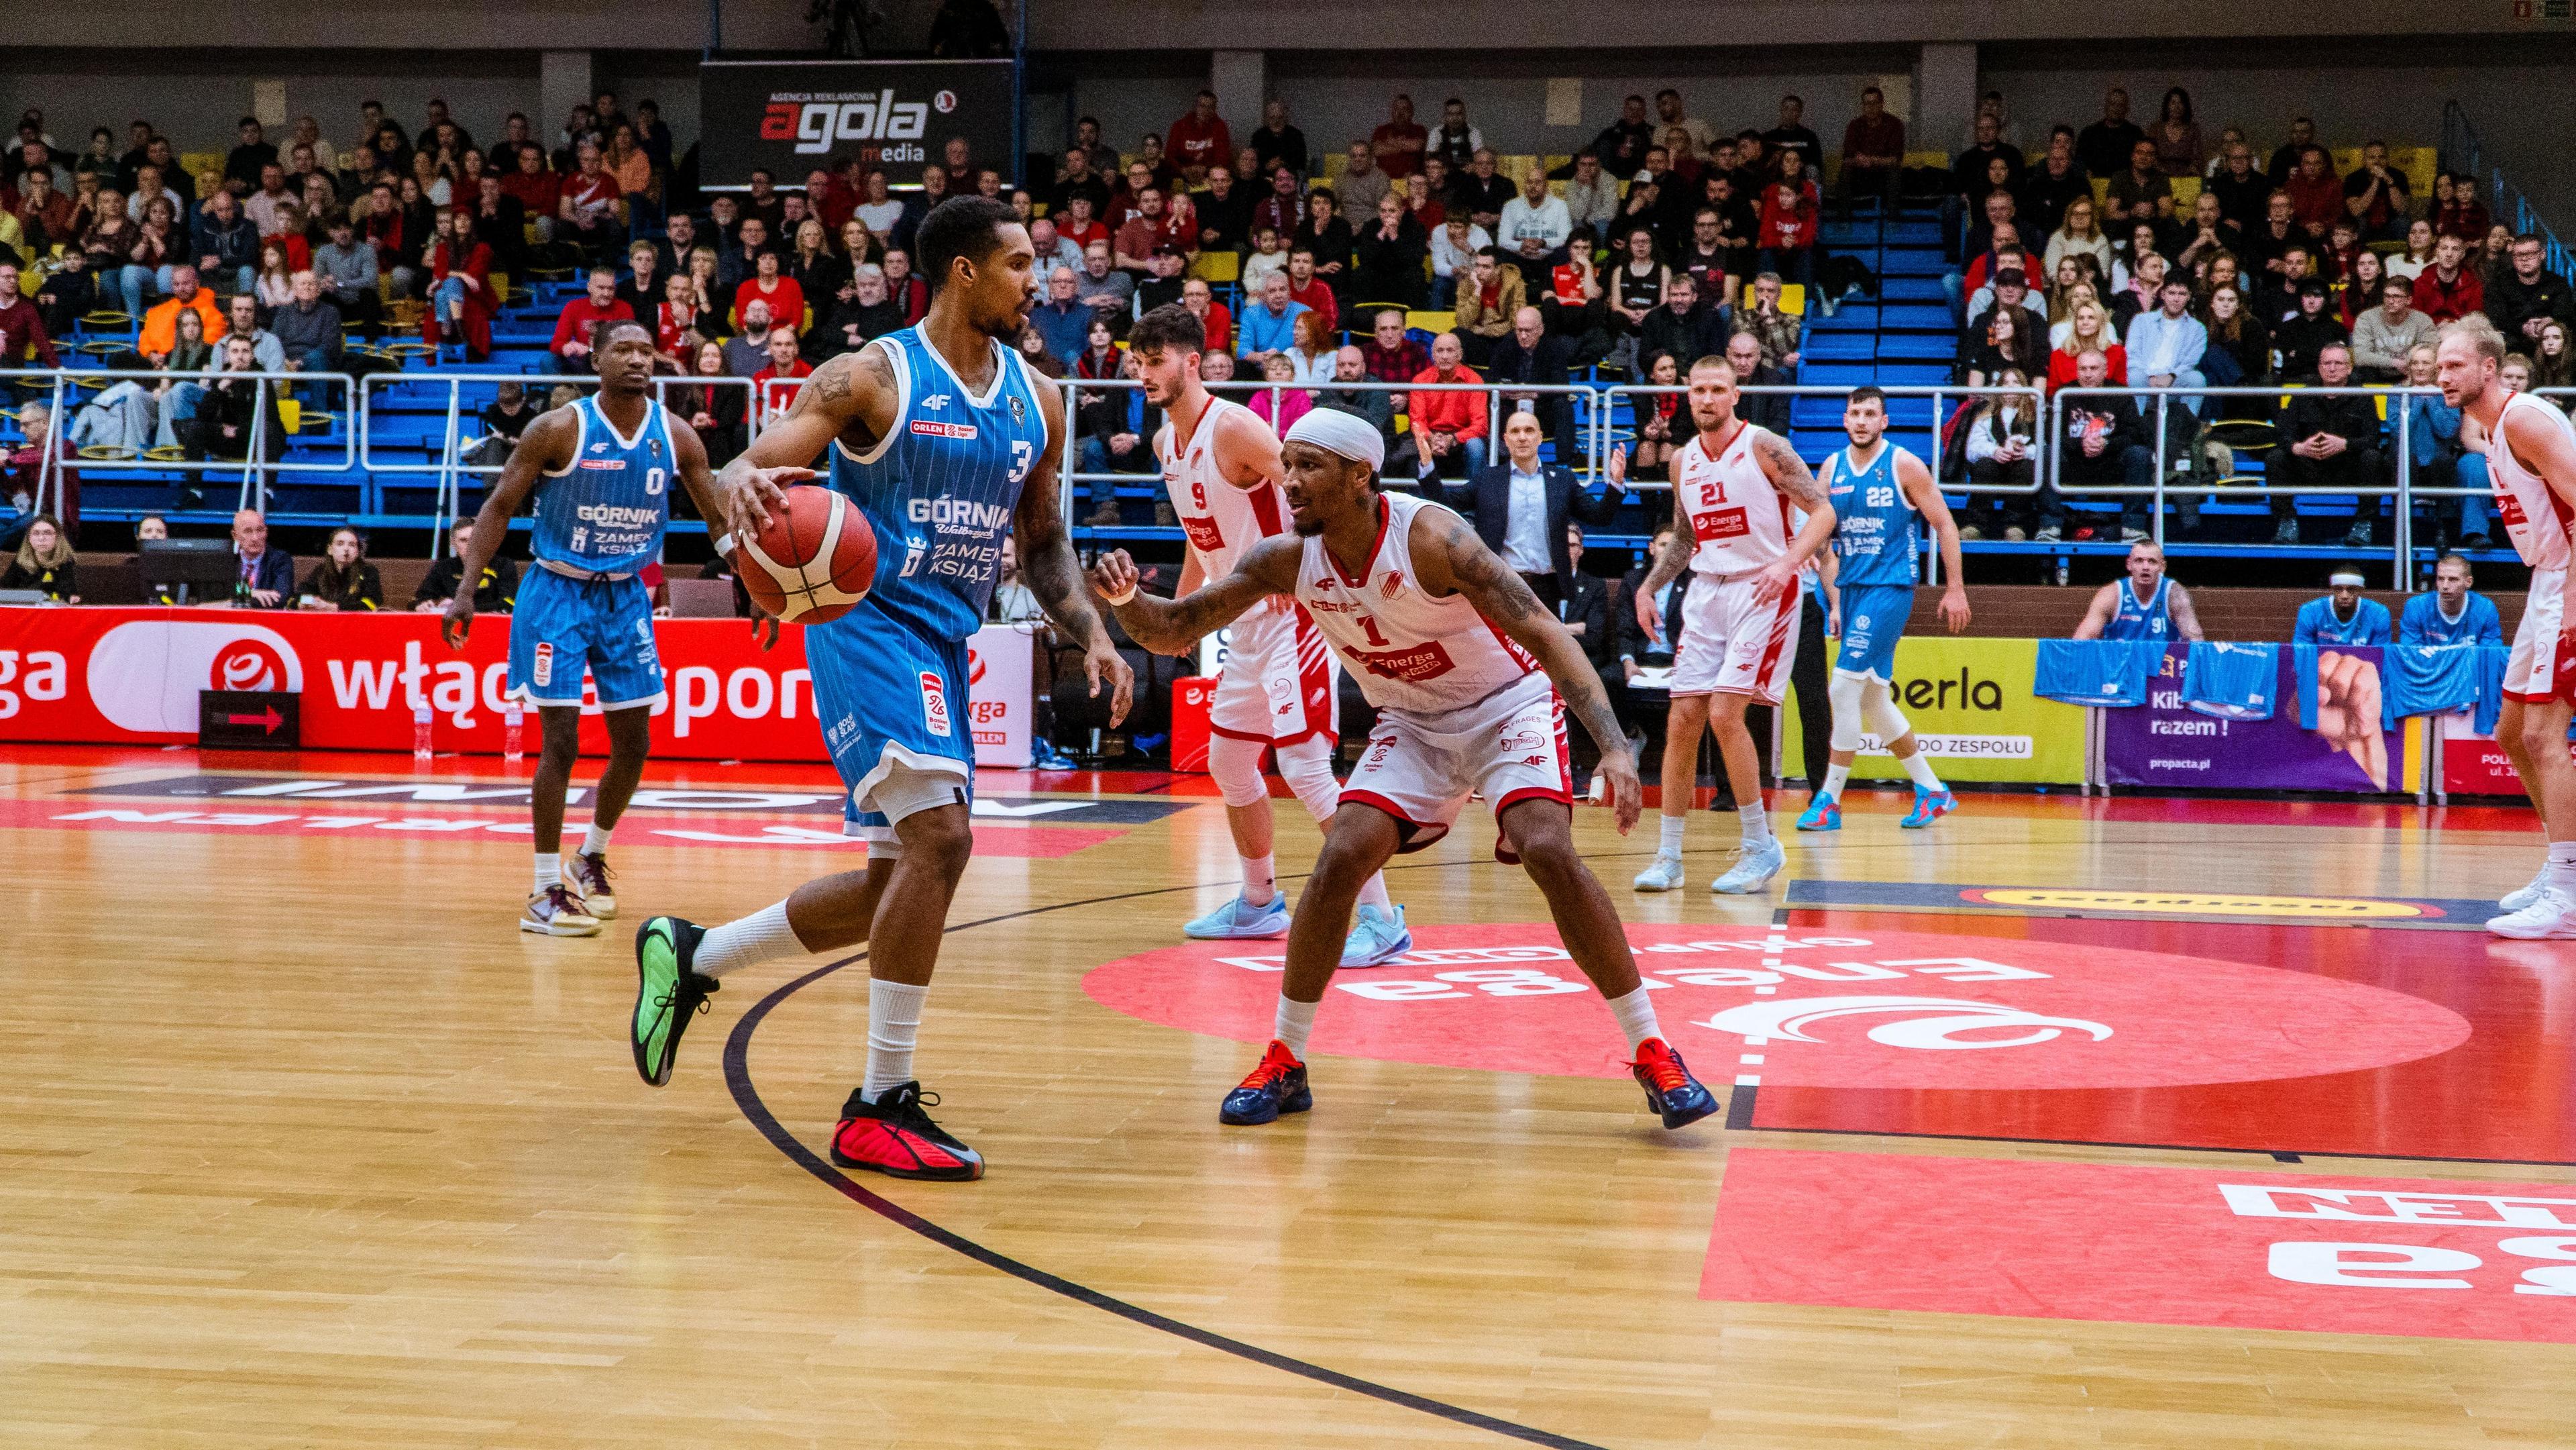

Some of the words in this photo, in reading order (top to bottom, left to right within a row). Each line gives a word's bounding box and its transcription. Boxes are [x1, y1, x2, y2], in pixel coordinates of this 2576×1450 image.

[761, 89, 928, 154] agola
[861, 144, 924, 162] media
[921, 394, 951, 411] 4F
[913, 424, 943, 433] ORLEN
[1008, 440, 1032, 483] 3
[645, 468, 665, 495] 0
[1191, 482, 1207, 510] 9
[1701, 481, 1728, 507] 21
[1866, 486, 1894, 507] 22
[577, 503, 660, 524] GÓRNIK
[928, 560, 994, 584] KSIĄŻ
[1356, 615, 1391, 647] 1
[2151, 617, 2167, 633] 91
[929, 717, 948, 725] Basket
[2151, 720, 2216, 736] razem
[2222, 719, 2229, 736] !
[1918, 739, 1943, 752] DO
[1948, 739, 2027, 754] ZESPOŁU
[2149, 759, 2211, 772] propacta.pl
